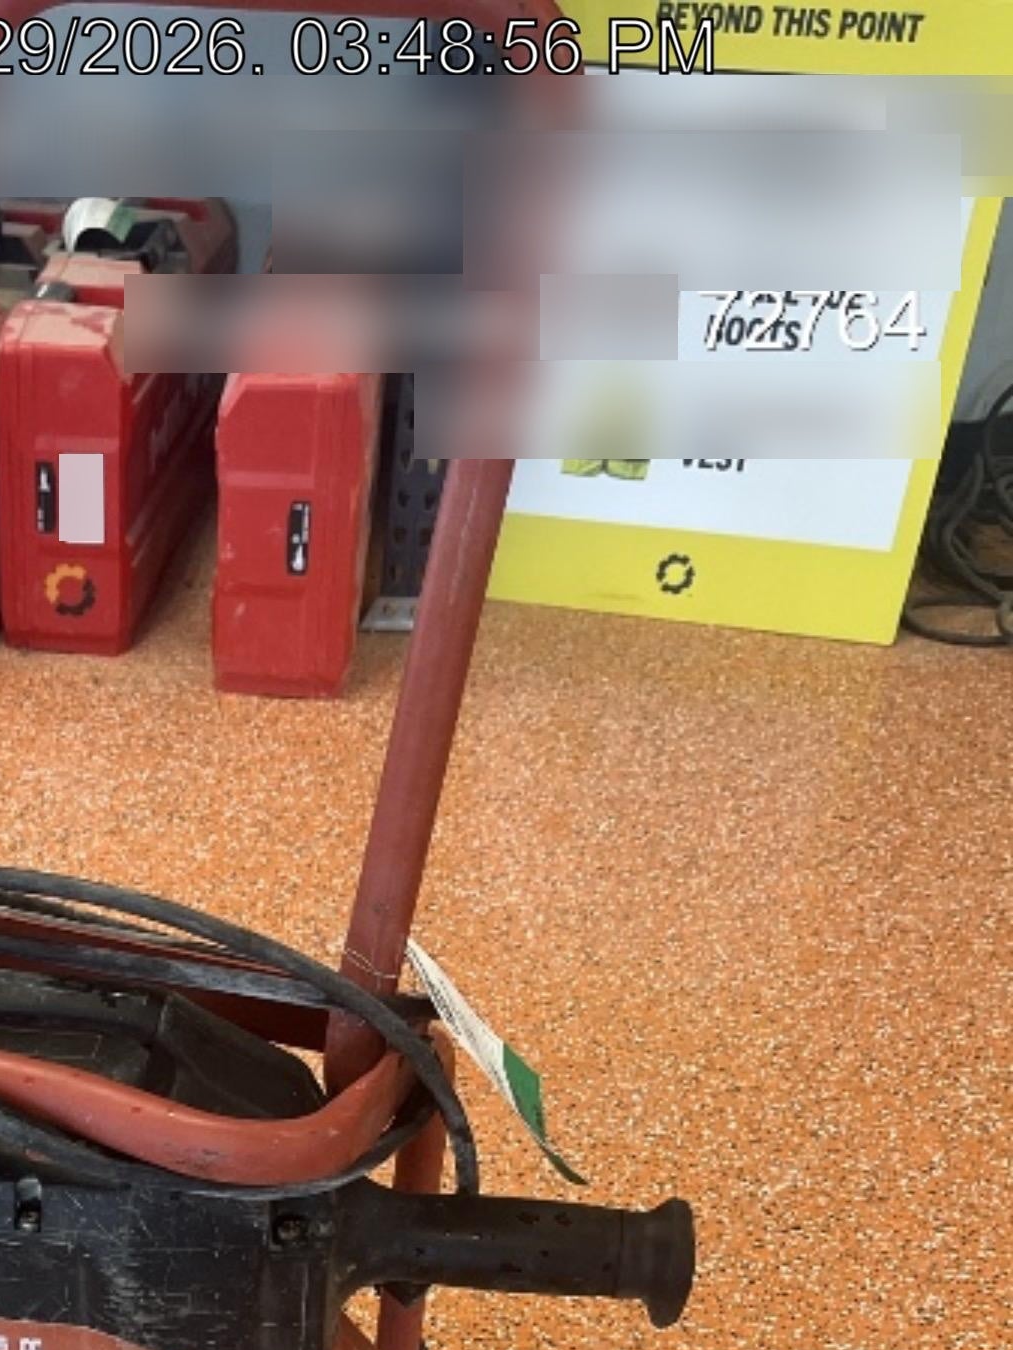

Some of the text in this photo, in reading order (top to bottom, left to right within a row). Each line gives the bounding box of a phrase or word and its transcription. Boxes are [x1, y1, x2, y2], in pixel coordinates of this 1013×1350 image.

[657, 1, 925, 43] BEYOND THIS POINT
